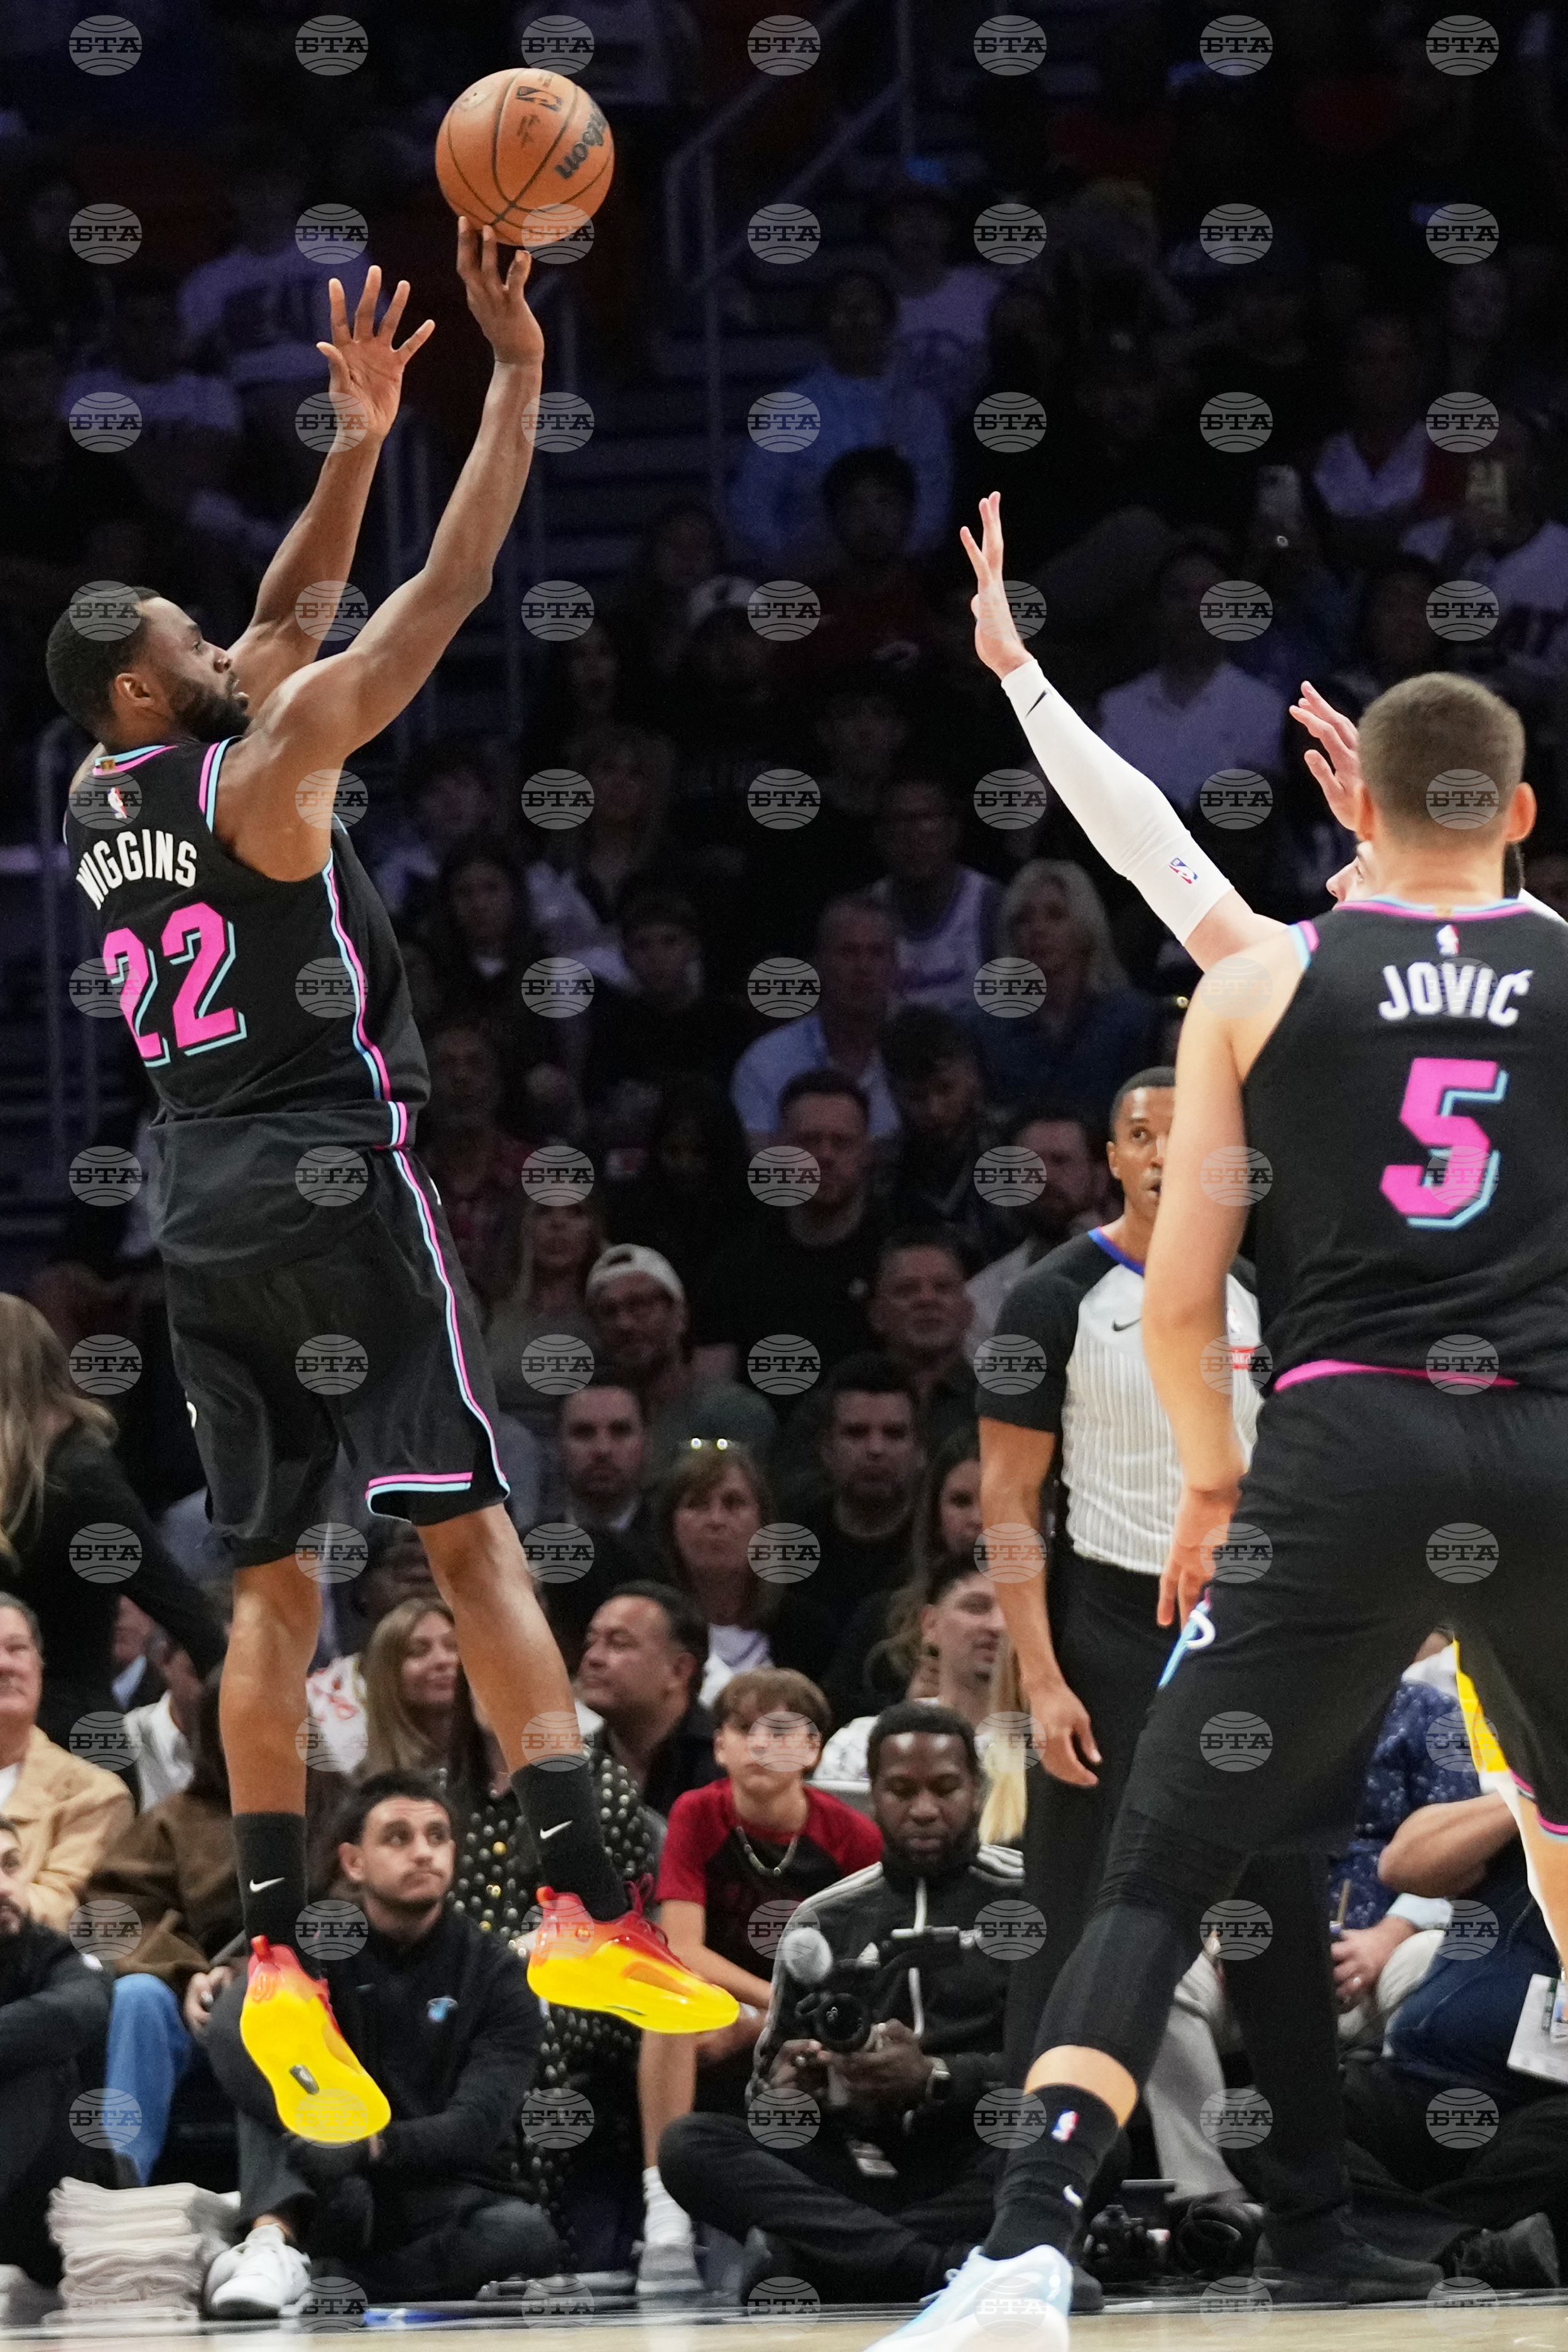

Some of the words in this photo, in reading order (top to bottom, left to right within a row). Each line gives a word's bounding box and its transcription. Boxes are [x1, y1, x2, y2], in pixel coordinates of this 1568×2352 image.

[76, 829, 197, 910] WIGGINS
[102, 902, 247, 1067] 22
[1380, 1057, 1508, 1229] 5
